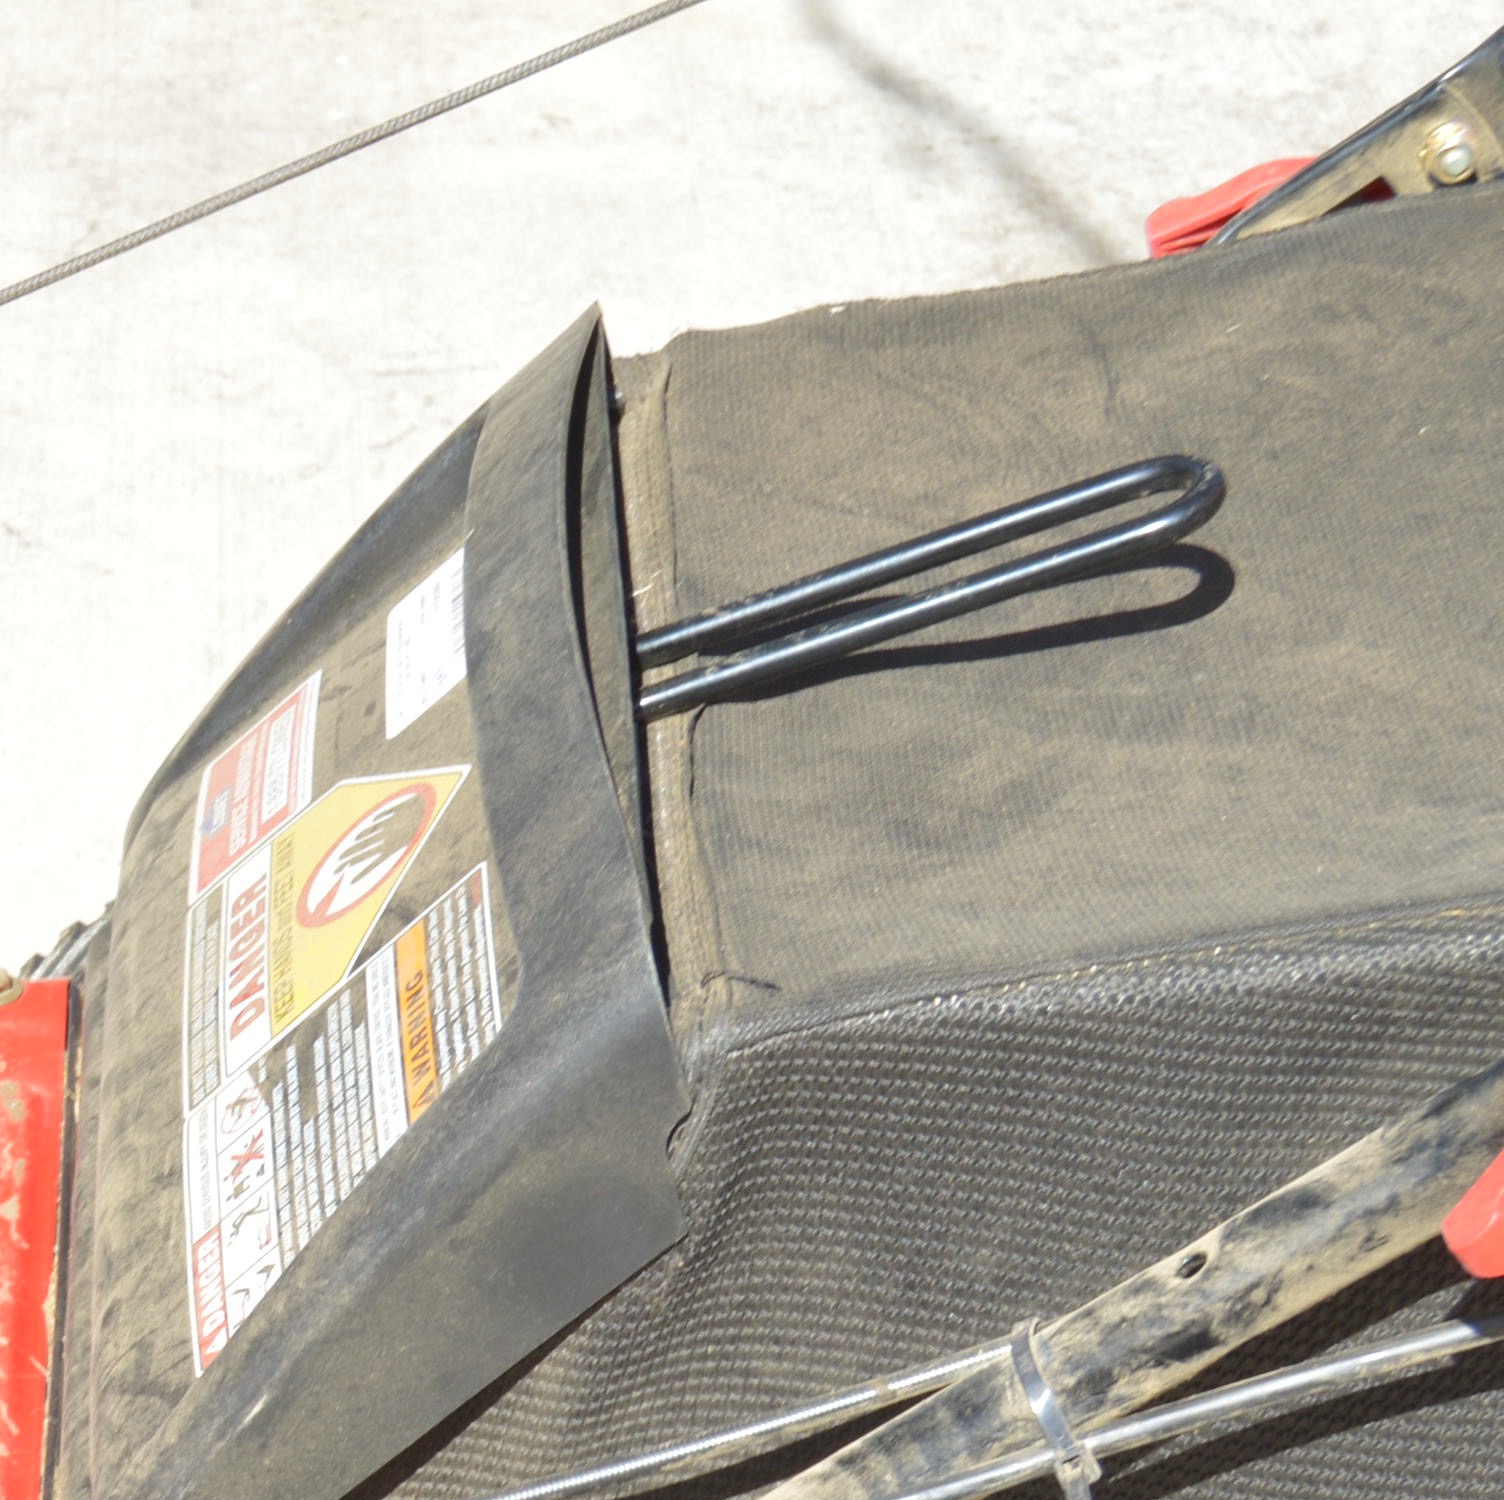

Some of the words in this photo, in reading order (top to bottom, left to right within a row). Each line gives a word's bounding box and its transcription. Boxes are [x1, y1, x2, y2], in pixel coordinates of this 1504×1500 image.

[274, 875, 294, 909] FEET
[228, 871, 269, 1041] DANGER
[273, 926, 293, 984] HANDS
[273, 977, 295, 1025] KEEP
[405, 969, 432, 1087] WARNING
[196, 1228, 228, 1335] DANGER
